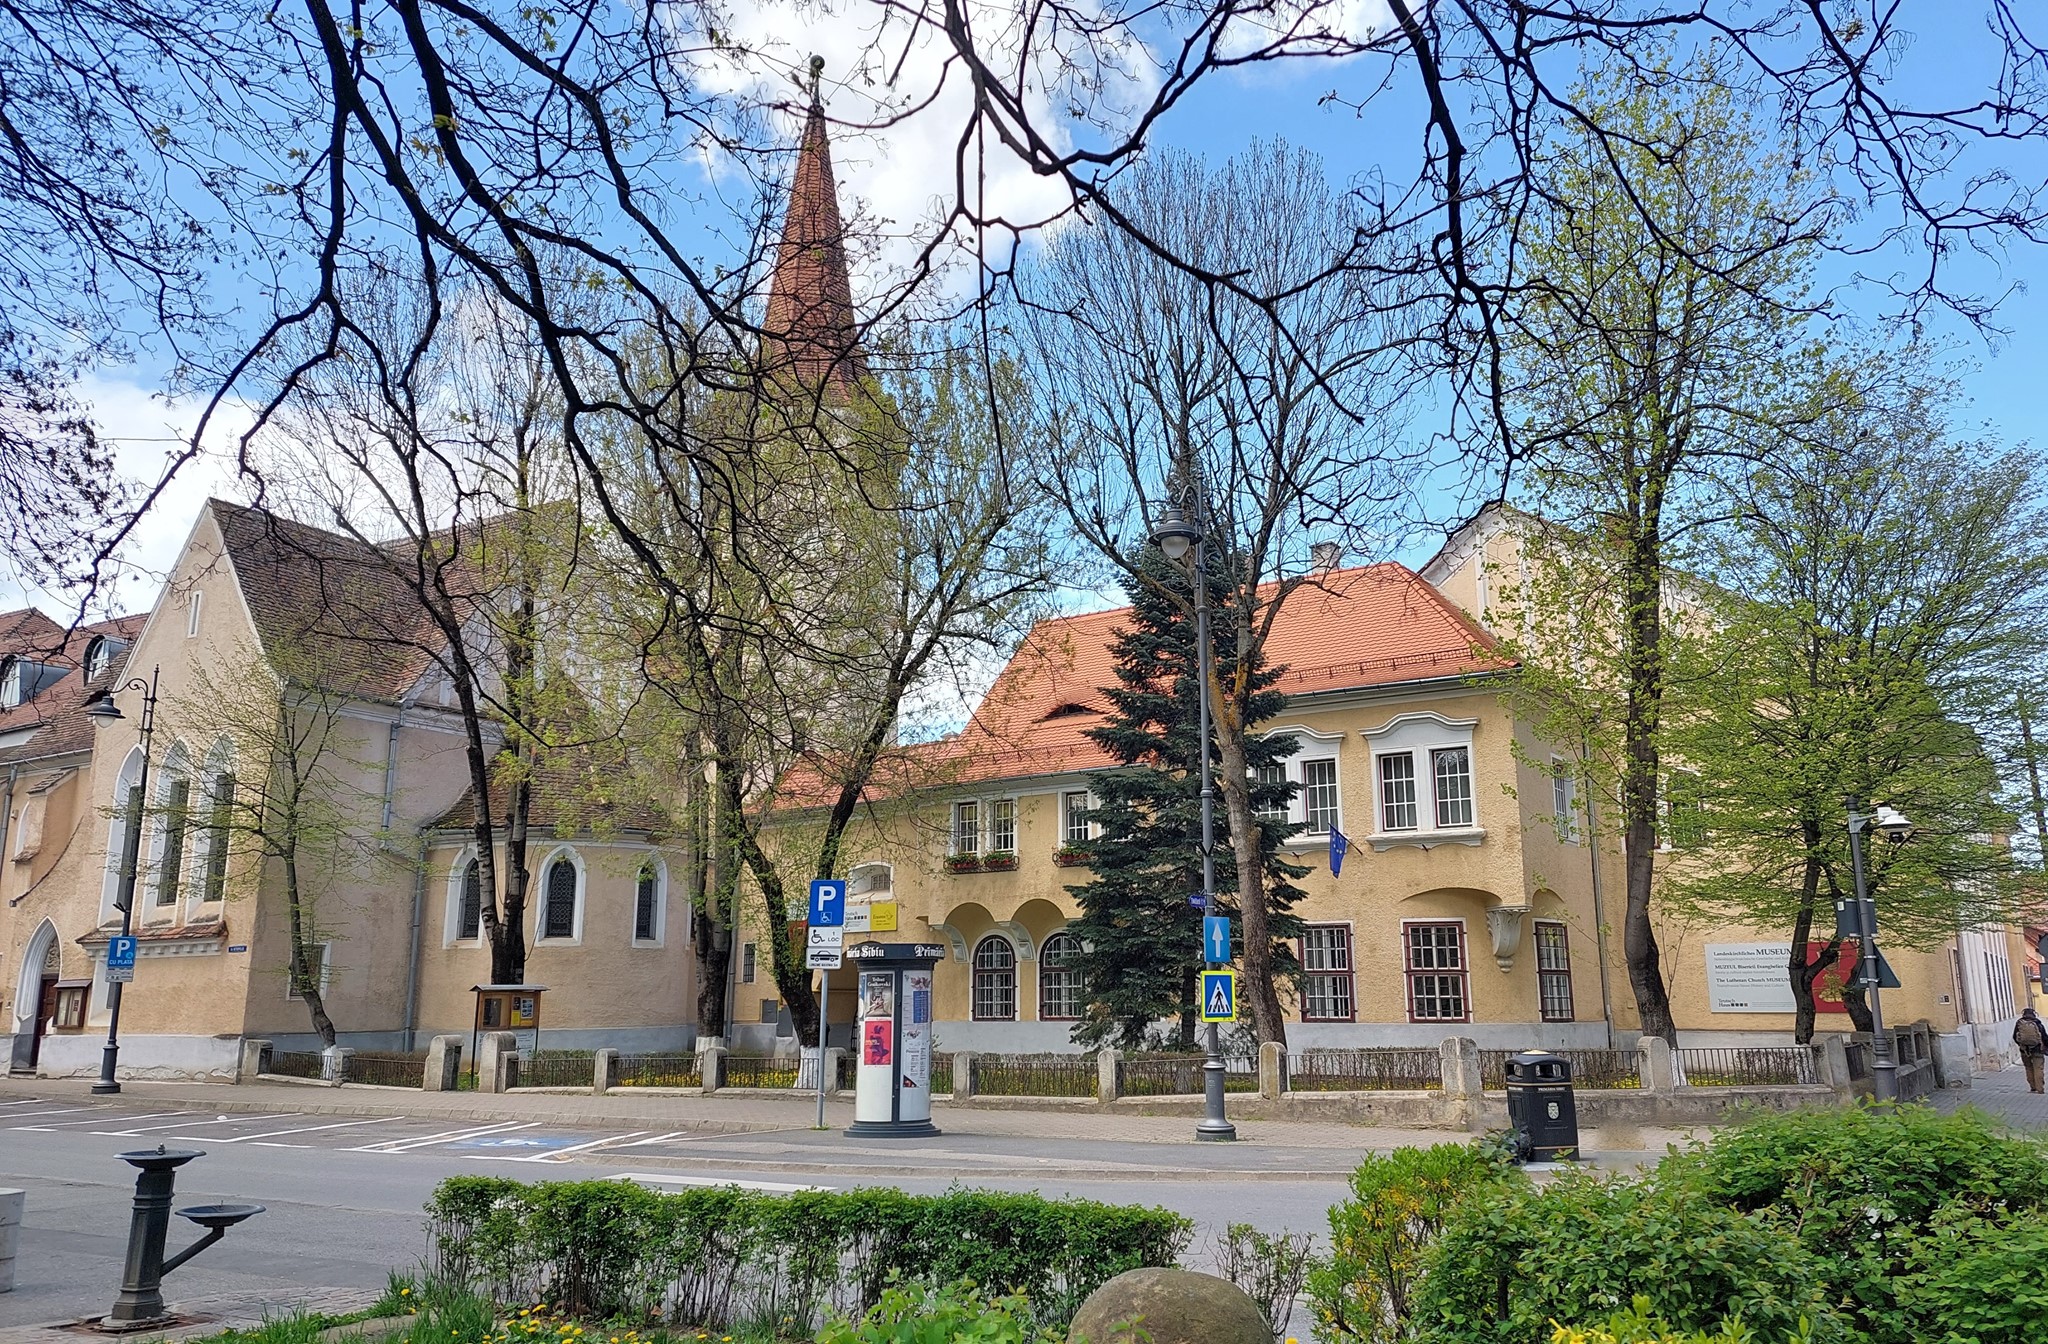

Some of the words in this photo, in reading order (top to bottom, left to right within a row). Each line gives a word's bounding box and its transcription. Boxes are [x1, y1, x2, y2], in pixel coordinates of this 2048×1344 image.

[818, 886, 836, 911] P
[117, 940, 130, 957] P
[861, 945, 884, 957] Sibiu
